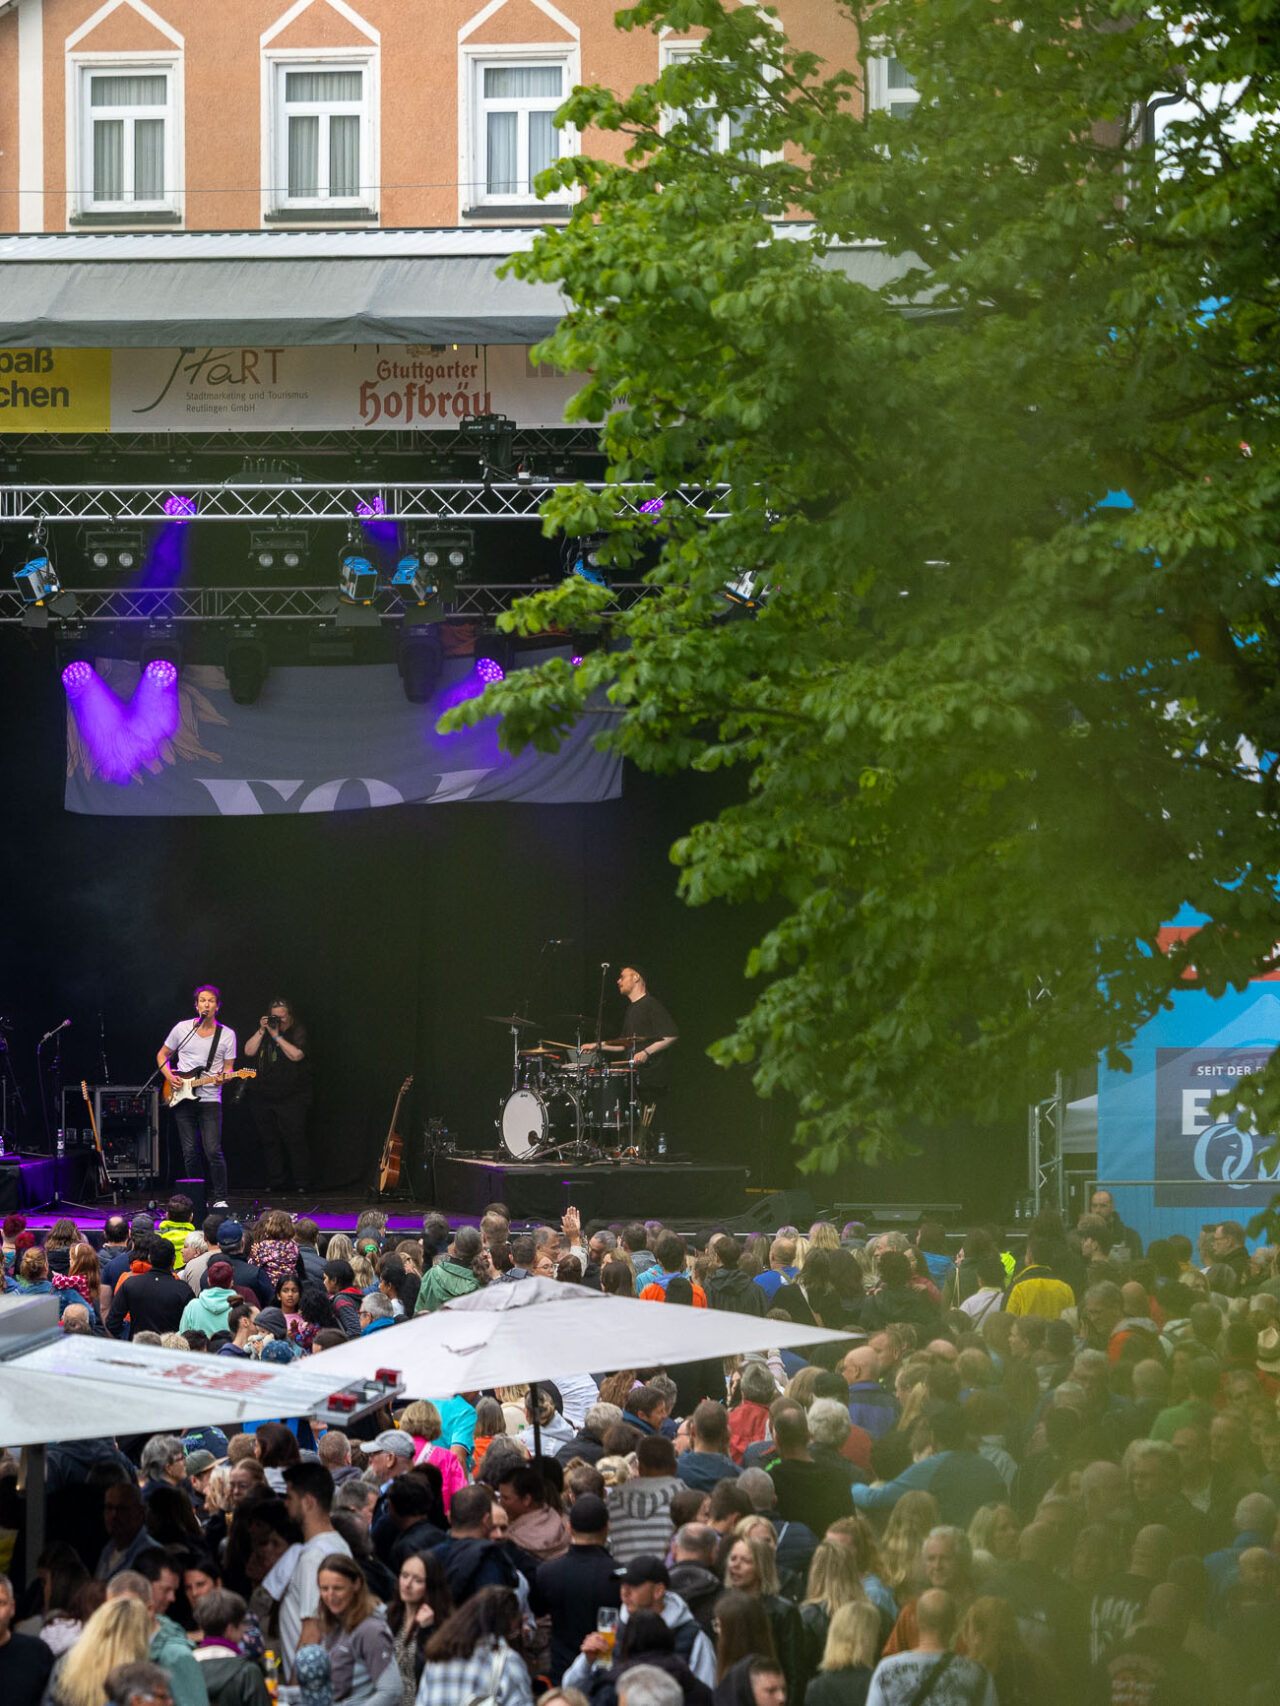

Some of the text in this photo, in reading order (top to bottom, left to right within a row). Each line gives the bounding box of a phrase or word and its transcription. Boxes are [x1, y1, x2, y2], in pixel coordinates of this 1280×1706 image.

[376, 360, 478, 384] Stuttgarter
[186, 391, 309, 401] Stadtmarketing und Tourismus
[186, 403, 255, 413] Reutlingen GmbH
[1197, 1066, 1223, 1076] SEIT
[1227, 1066, 1252, 1076] DER
